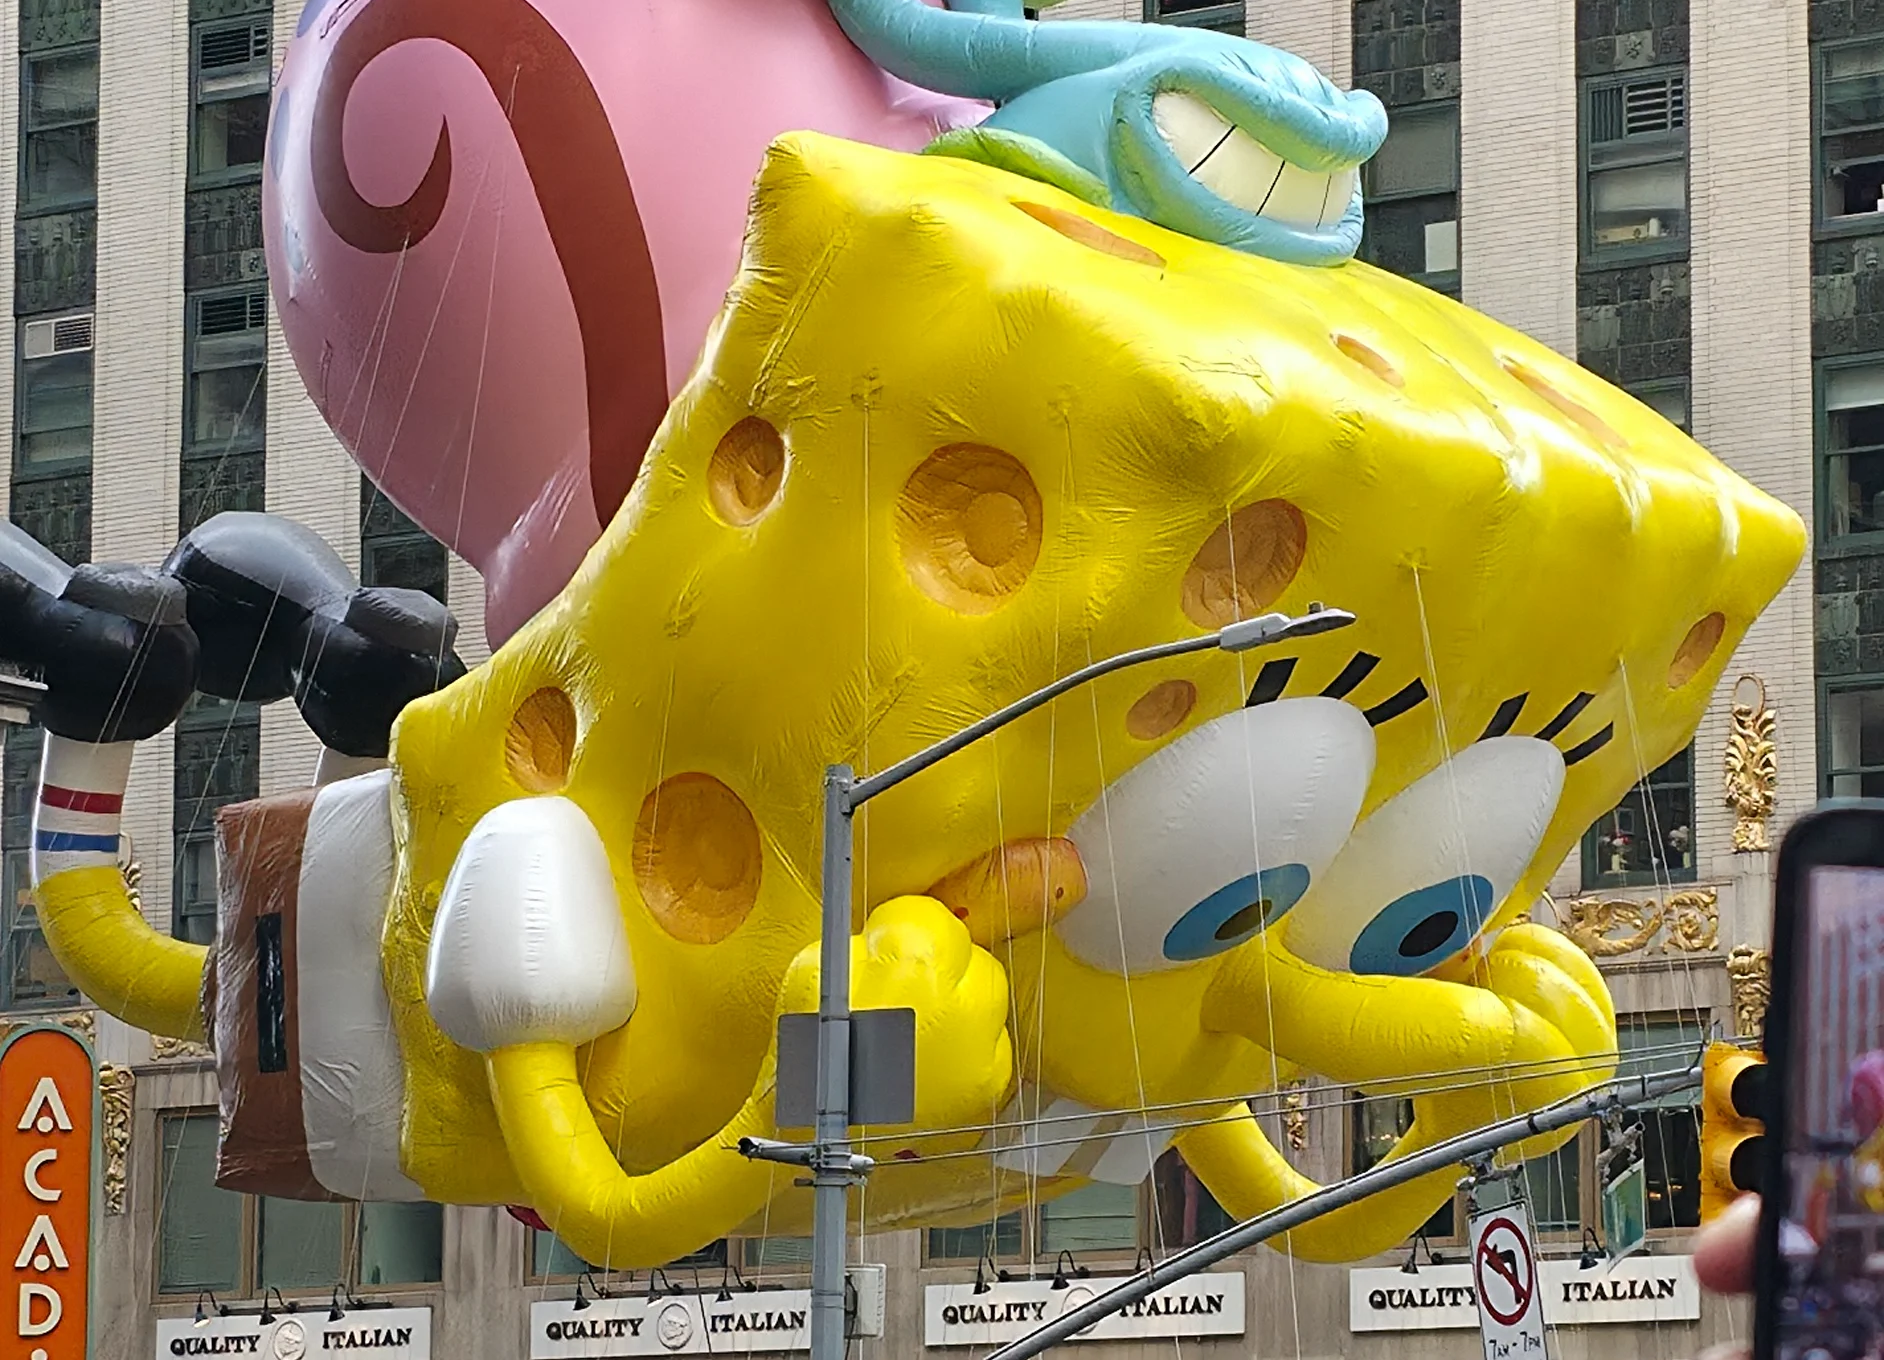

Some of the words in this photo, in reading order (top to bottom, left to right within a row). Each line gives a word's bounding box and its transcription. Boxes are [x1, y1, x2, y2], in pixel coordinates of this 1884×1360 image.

[1369, 1286, 1476, 1310] QUALITY
[1562, 1278, 1677, 1303] ITALIAN
[546, 1318, 644, 1340] QUALITY
[710, 1311, 806, 1333] ITALIAN
[943, 1301, 1047, 1324] QUALITY
[170, 1335, 260, 1356] QUALITY
[322, 1328, 412, 1350] ITALIAN
